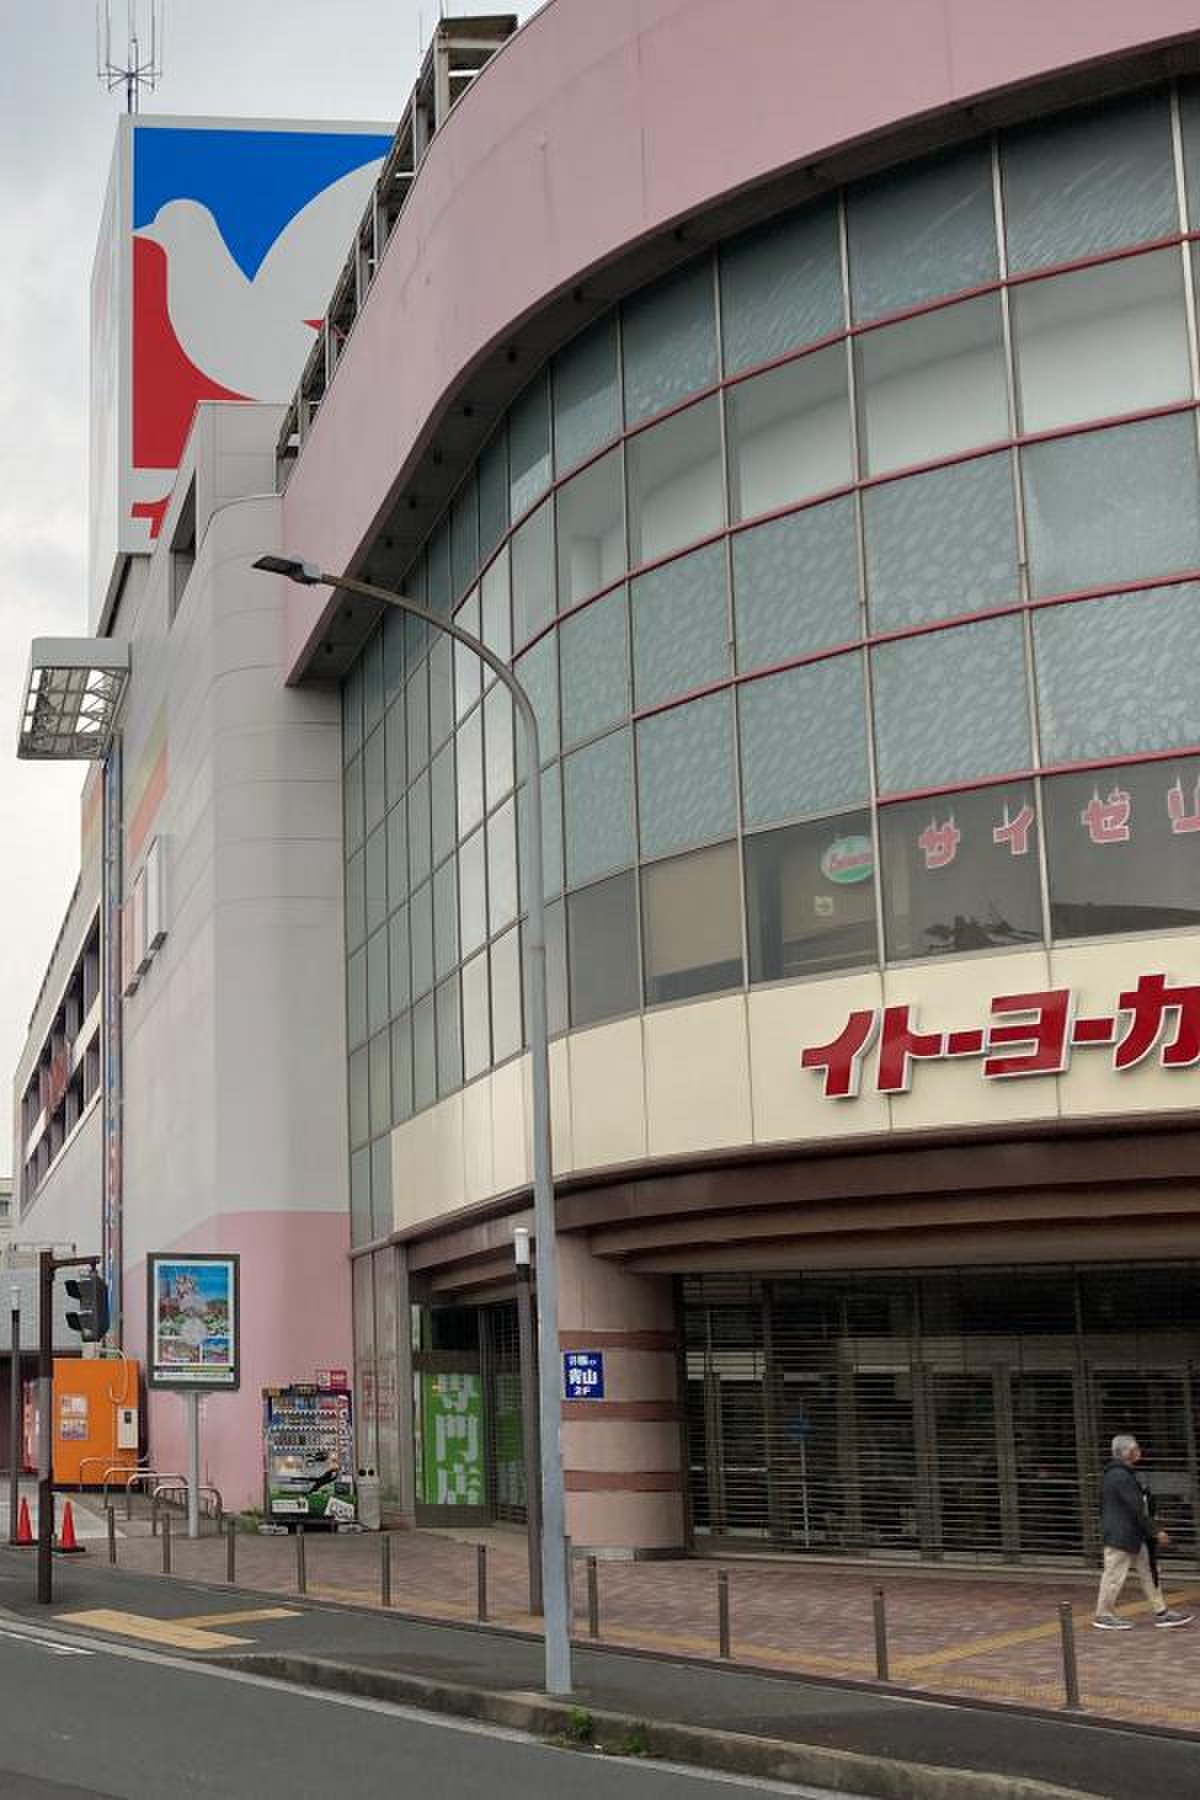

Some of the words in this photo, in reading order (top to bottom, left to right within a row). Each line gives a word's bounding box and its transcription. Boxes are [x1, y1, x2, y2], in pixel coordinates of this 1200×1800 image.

[801, 974, 1200, 1097] イトーヨーカ
[569, 1368, 597, 1385] 青山
